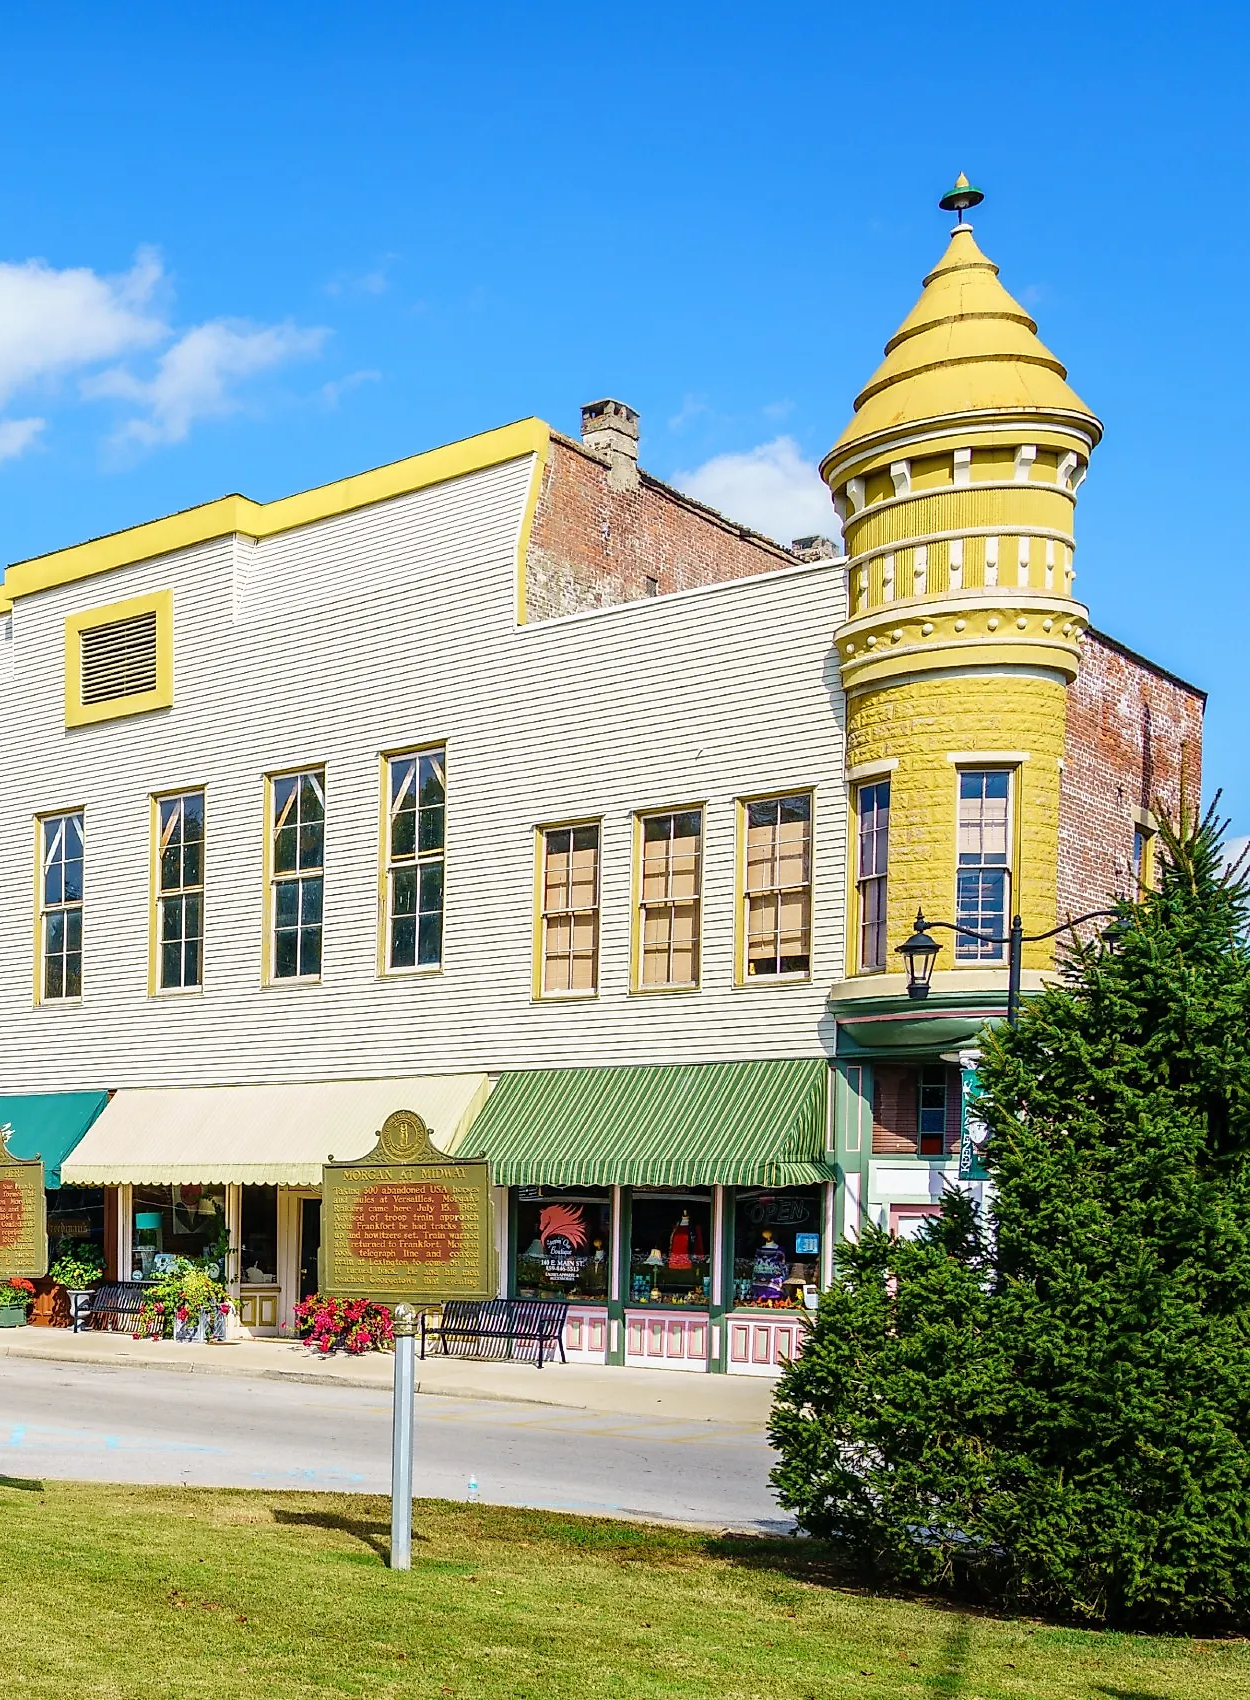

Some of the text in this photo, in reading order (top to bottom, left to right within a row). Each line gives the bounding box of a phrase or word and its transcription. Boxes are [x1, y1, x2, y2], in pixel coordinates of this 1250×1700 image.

[343, 1167, 467, 1181] MORGAN AT MIDWAY
[364, 1186, 378, 1195] 300
[382, 1186, 425, 1195] abandoned
[430, 1186, 447, 1195] USA
[417, 1204, 434, 1213] July
[750, 1199, 805, 1223] OPEN
[440, 1213, 478, 1222] approach
[357, 1222, 395, 1230] Frankfort
[351, 1240, 385, 1248] returned
[389, 1240, 396, 1248] to
[448, 1240, 478, 1250] Morgan
[359, 1249, 395, 1259] telegraph
[403, 1249, 418, 1257] line
[426, 1250, 441, 1258] and
[449, 1250, 479, 1258] coaxed
[369, 1259, 408, 1268] Lexington
[370, 1276, 416, 1286] Georgetown
